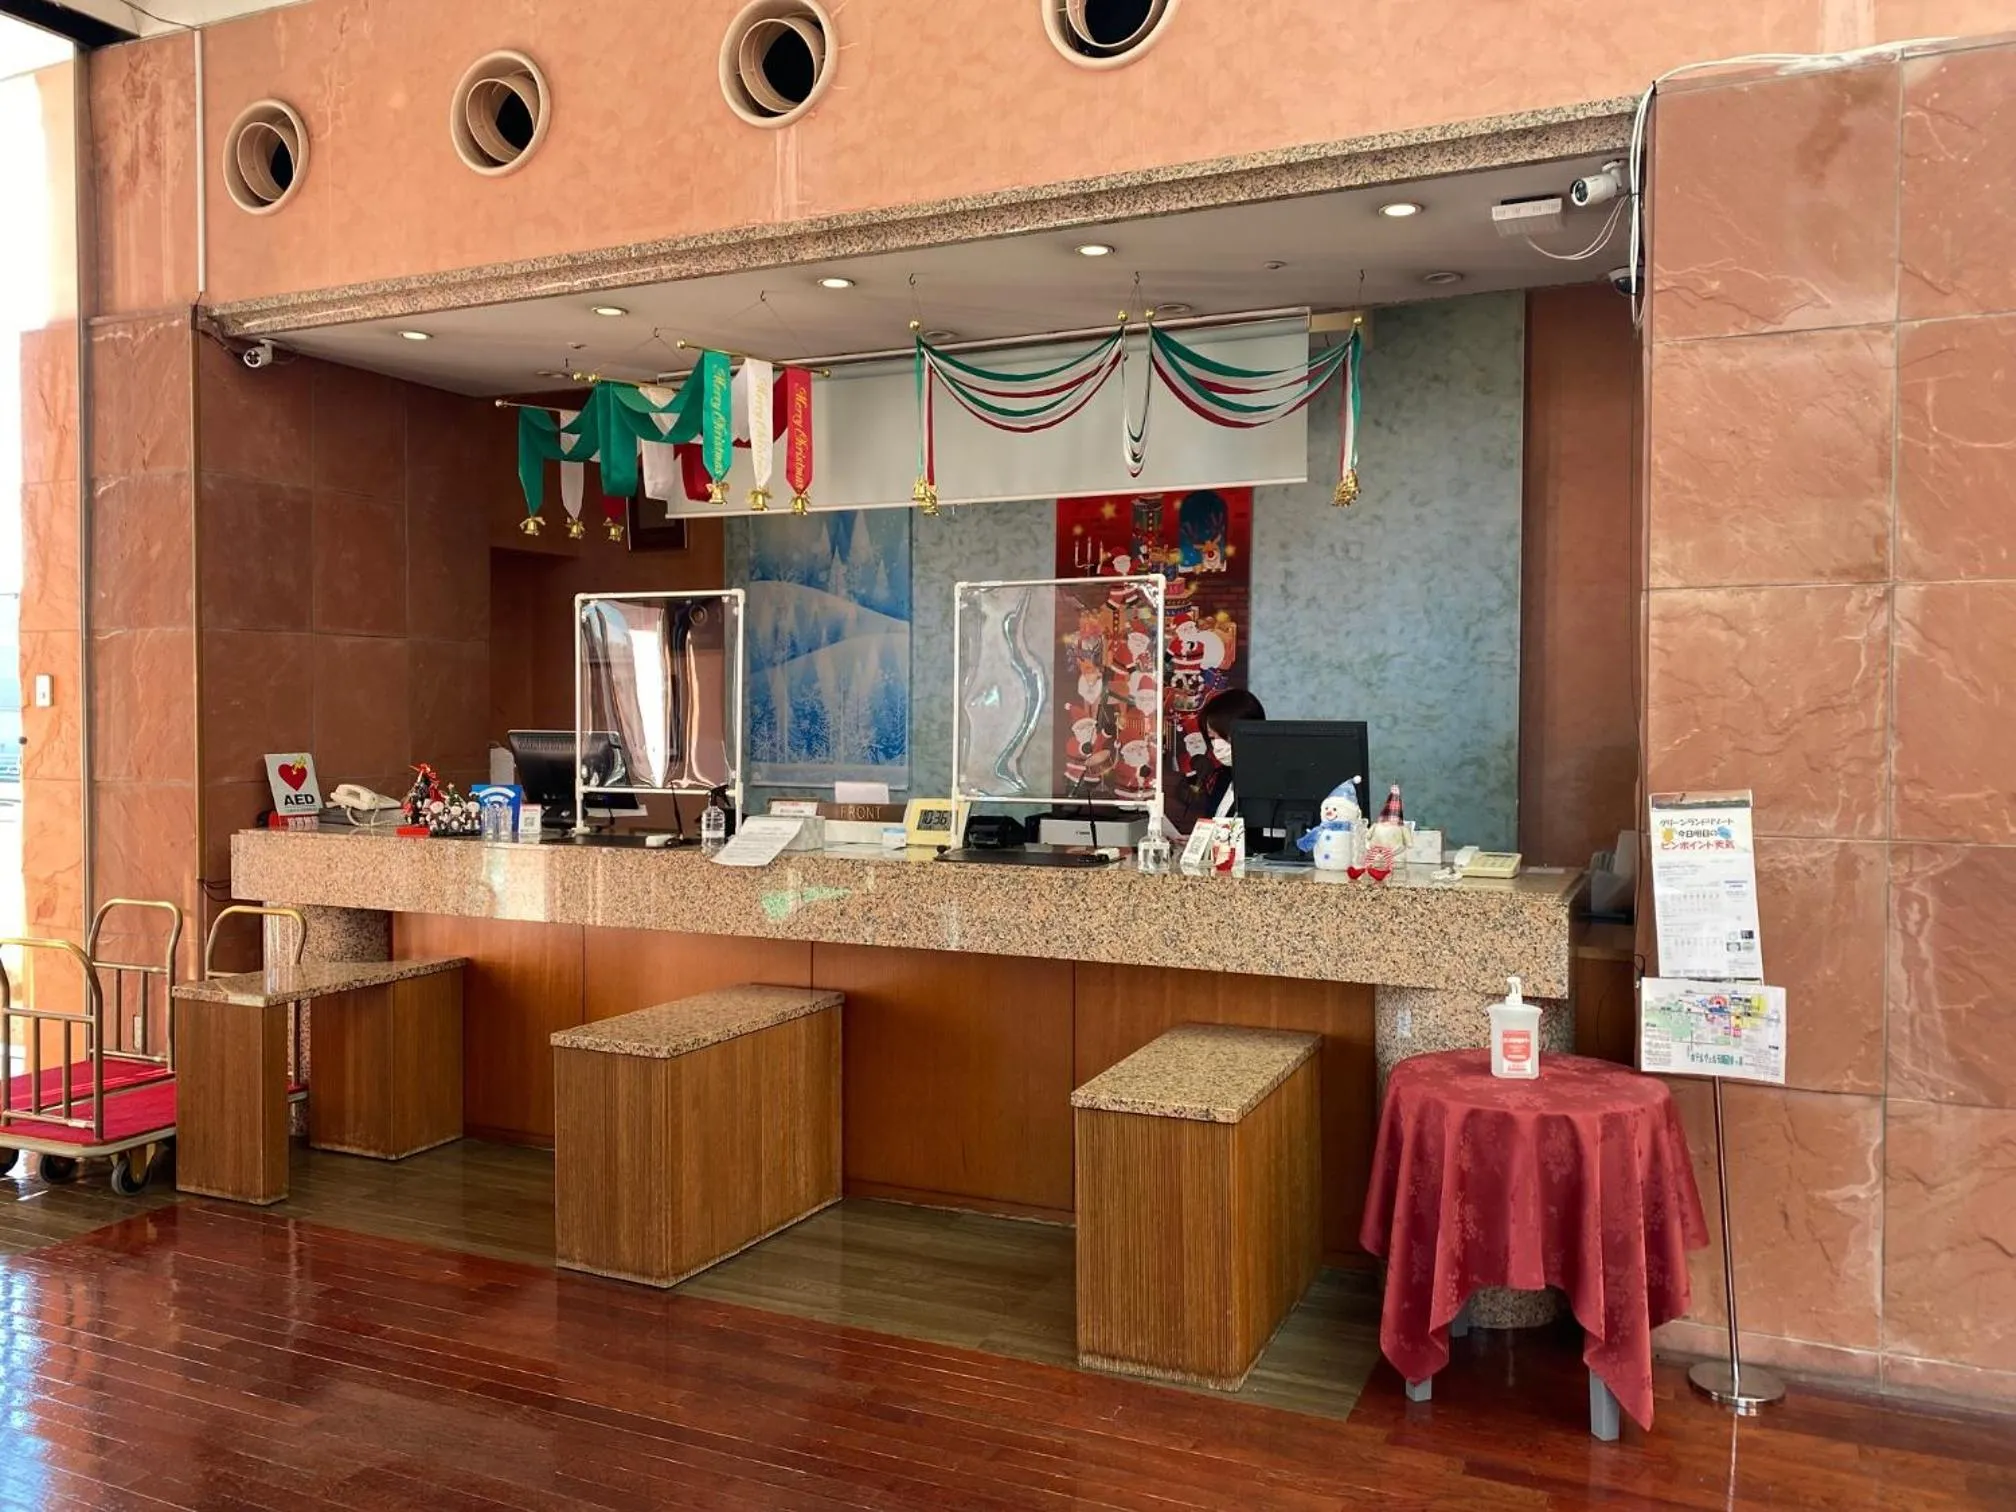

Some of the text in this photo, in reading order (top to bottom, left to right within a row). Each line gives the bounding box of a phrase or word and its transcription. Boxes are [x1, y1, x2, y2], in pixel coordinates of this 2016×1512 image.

[710, 366, 727, 475] Merry Christmas
[792, 387, 809, 490] Merry Christmas
[284, 794, 315, 806] AED
[840, 806, 881, 821] FRONT
